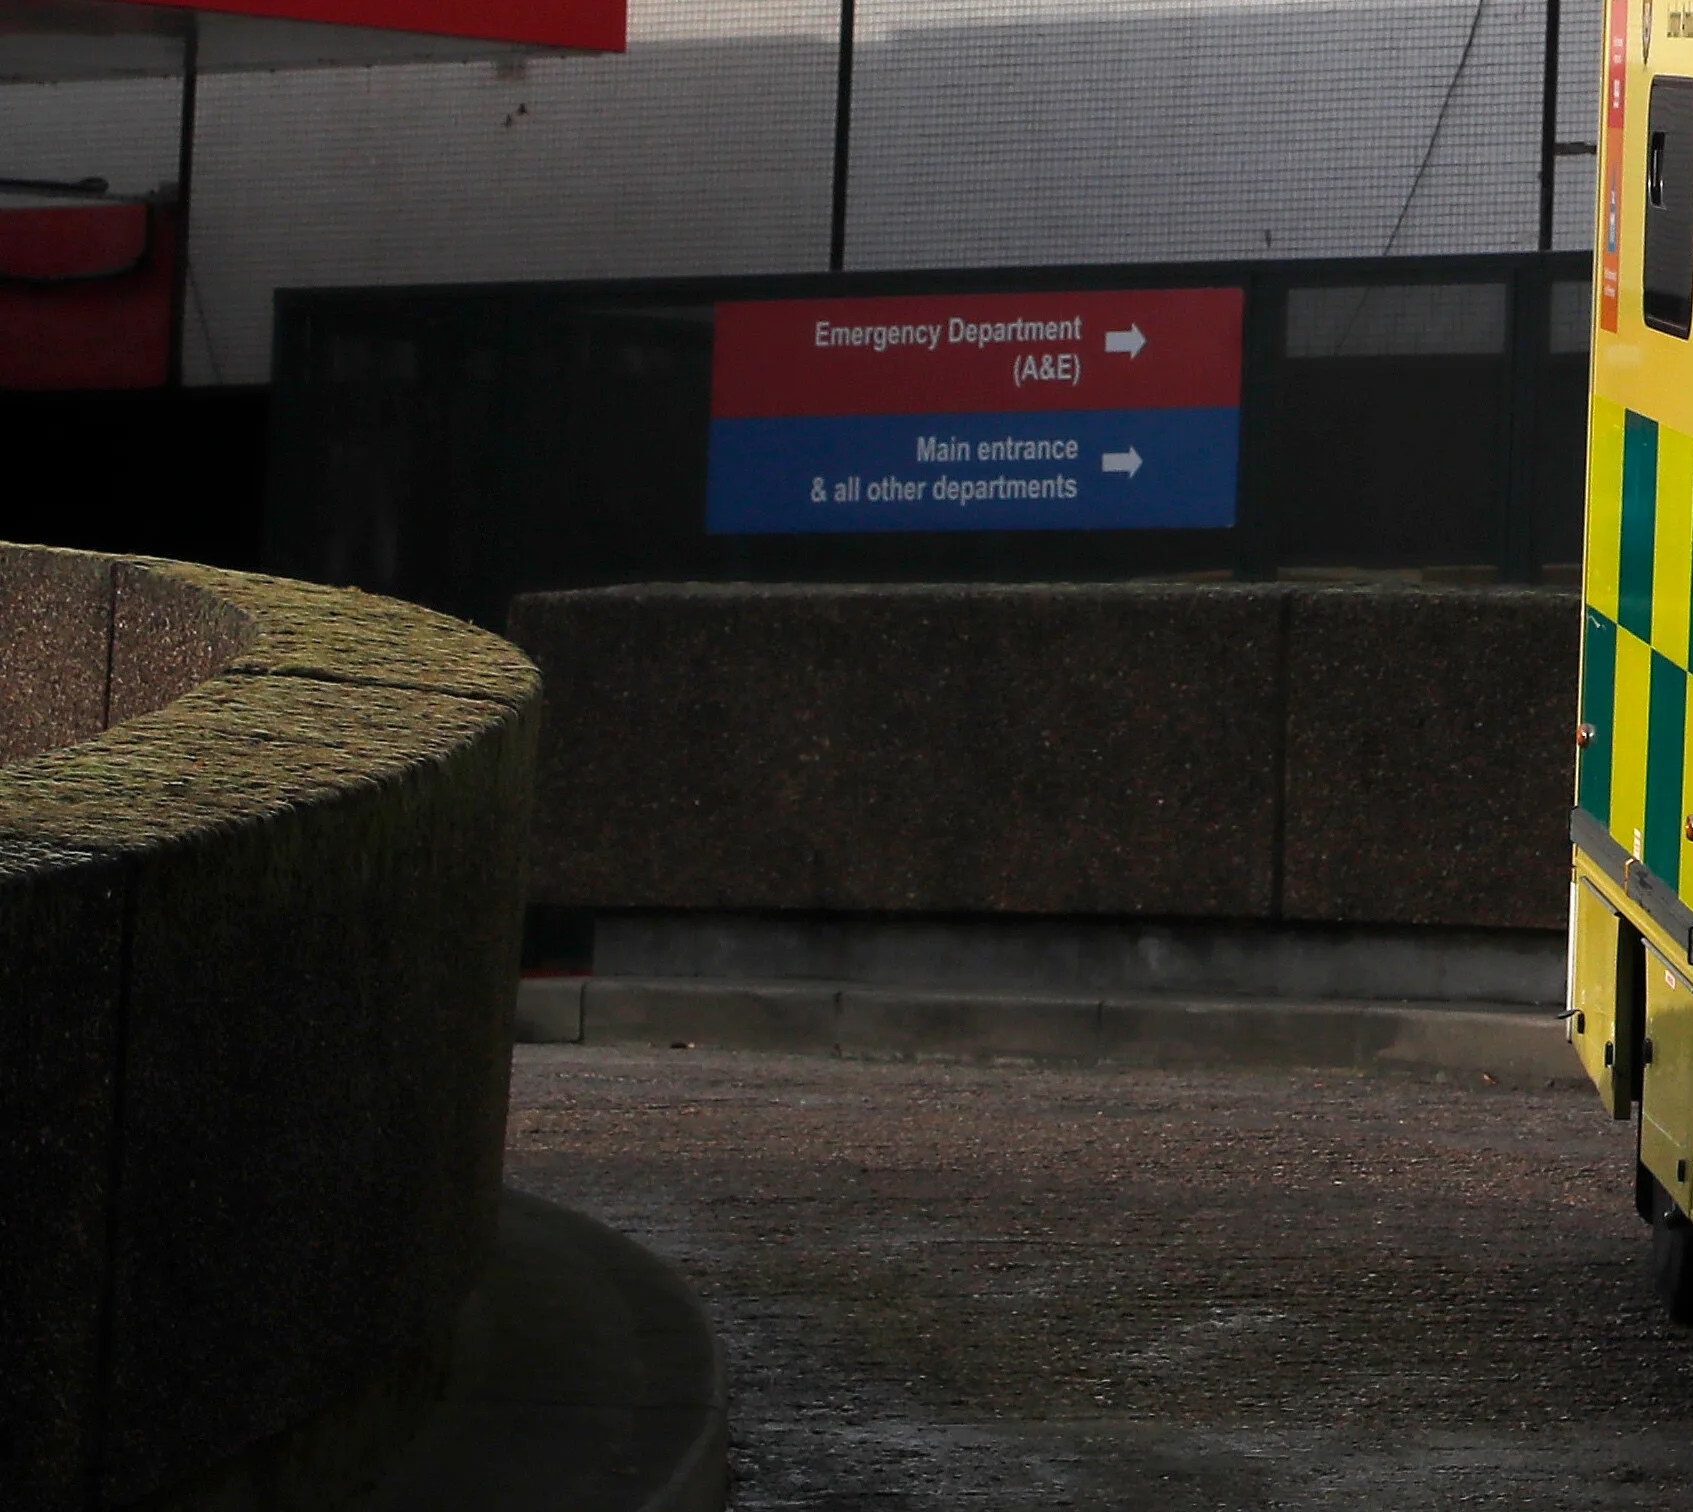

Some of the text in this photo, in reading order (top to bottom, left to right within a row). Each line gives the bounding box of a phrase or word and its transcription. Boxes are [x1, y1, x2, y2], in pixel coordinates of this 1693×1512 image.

[815, 316, 1082, 351] Emergency Department
[1014, 354, 1081, 386] (A&E)
[917, 436, 1078, 463] Main entrance
[810, 475, 1078, 506] & all other departments
